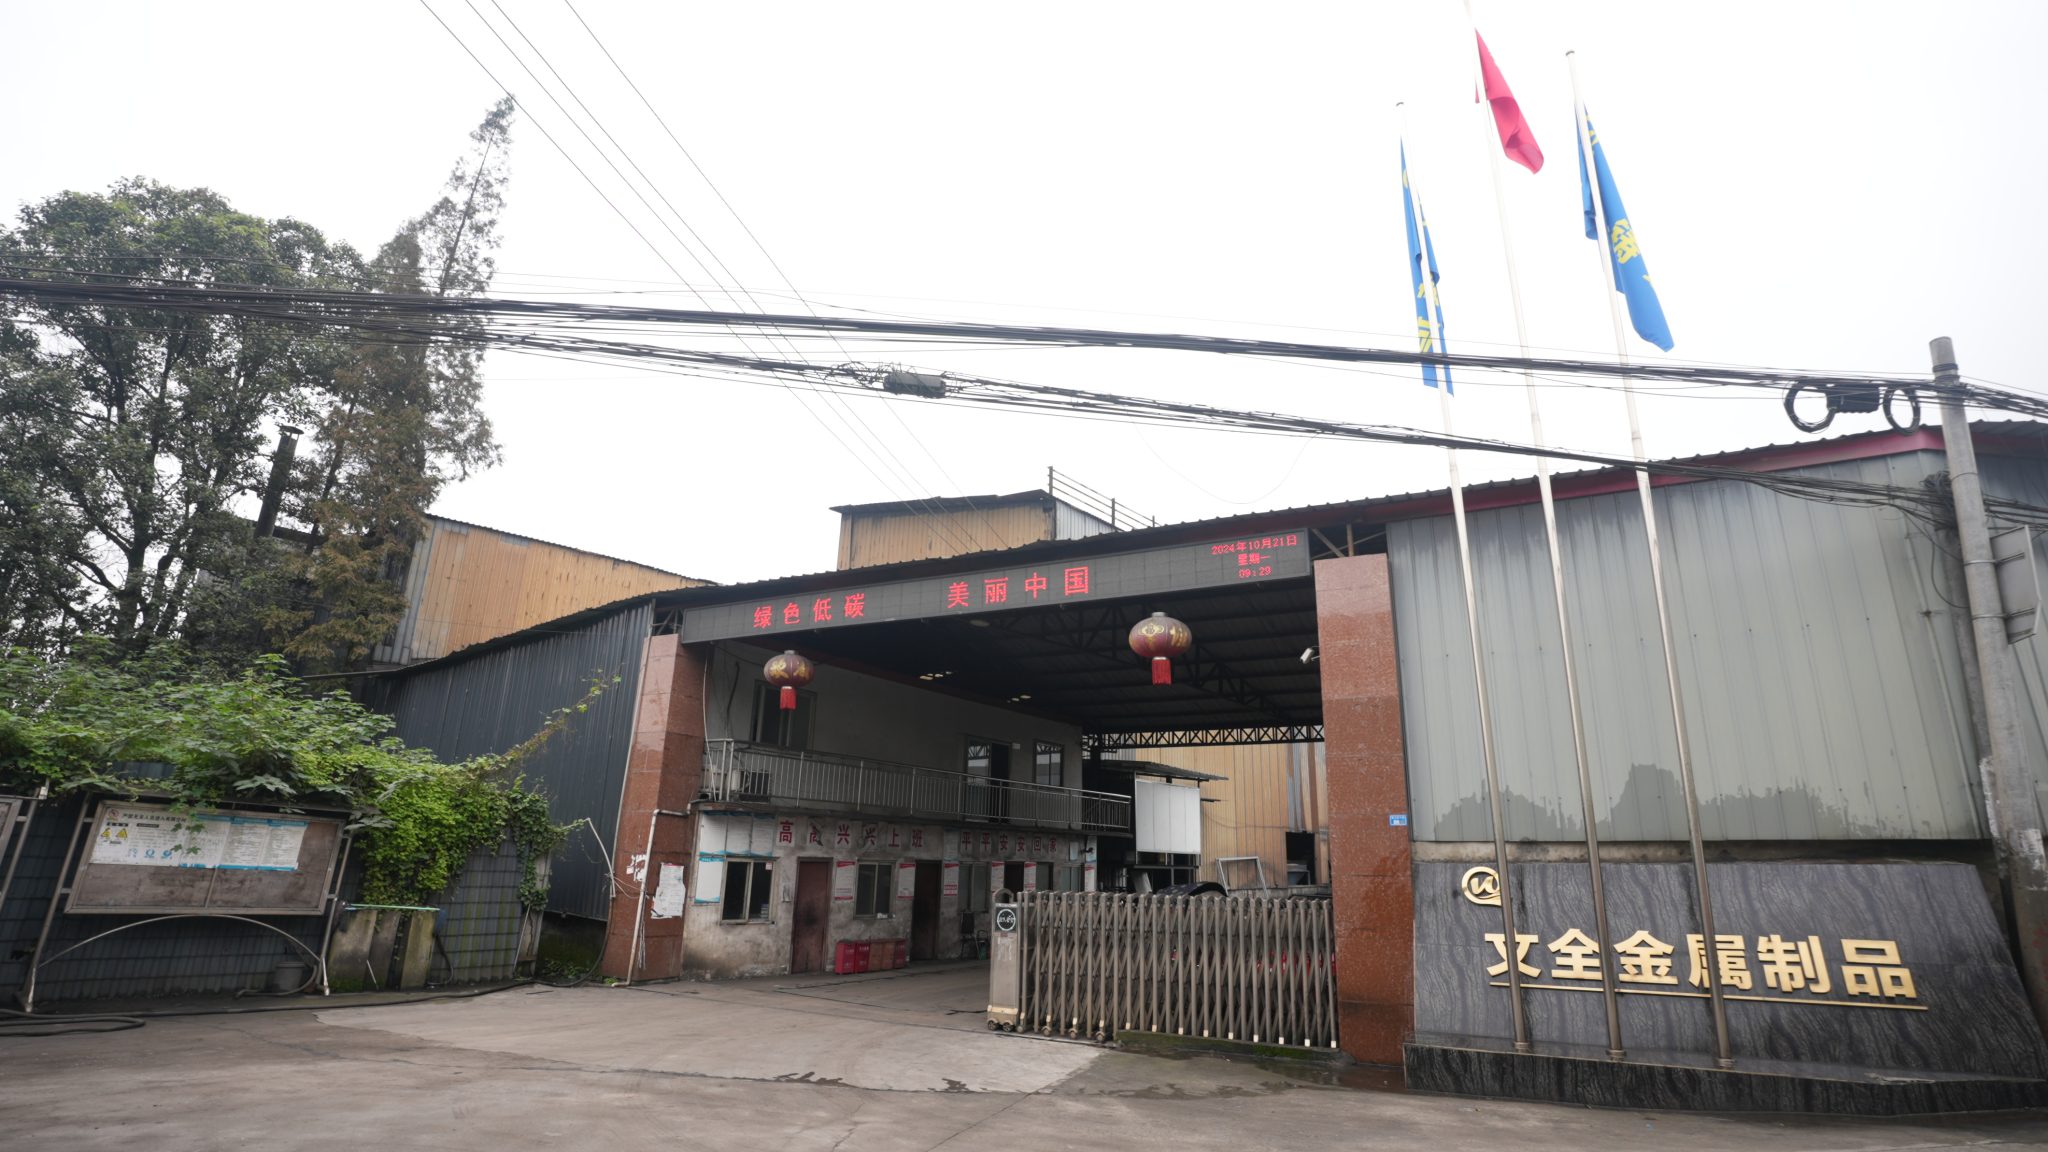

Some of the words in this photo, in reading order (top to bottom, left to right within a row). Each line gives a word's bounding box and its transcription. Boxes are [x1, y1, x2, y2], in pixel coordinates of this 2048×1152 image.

[1211, 534, 1297, 555] 2024年10月21日
[1237, 552, 1271, 566] 星期一
[1238, 566, 1272, 578] 09:29
[753, 593, 865, 629] 绿色低碳
[947, 566, 1089, 609] 美丽中国
[961, 831, 1057, 852] 平平安安回家
[1484, 927, 1917, 998] 文全金属制品
